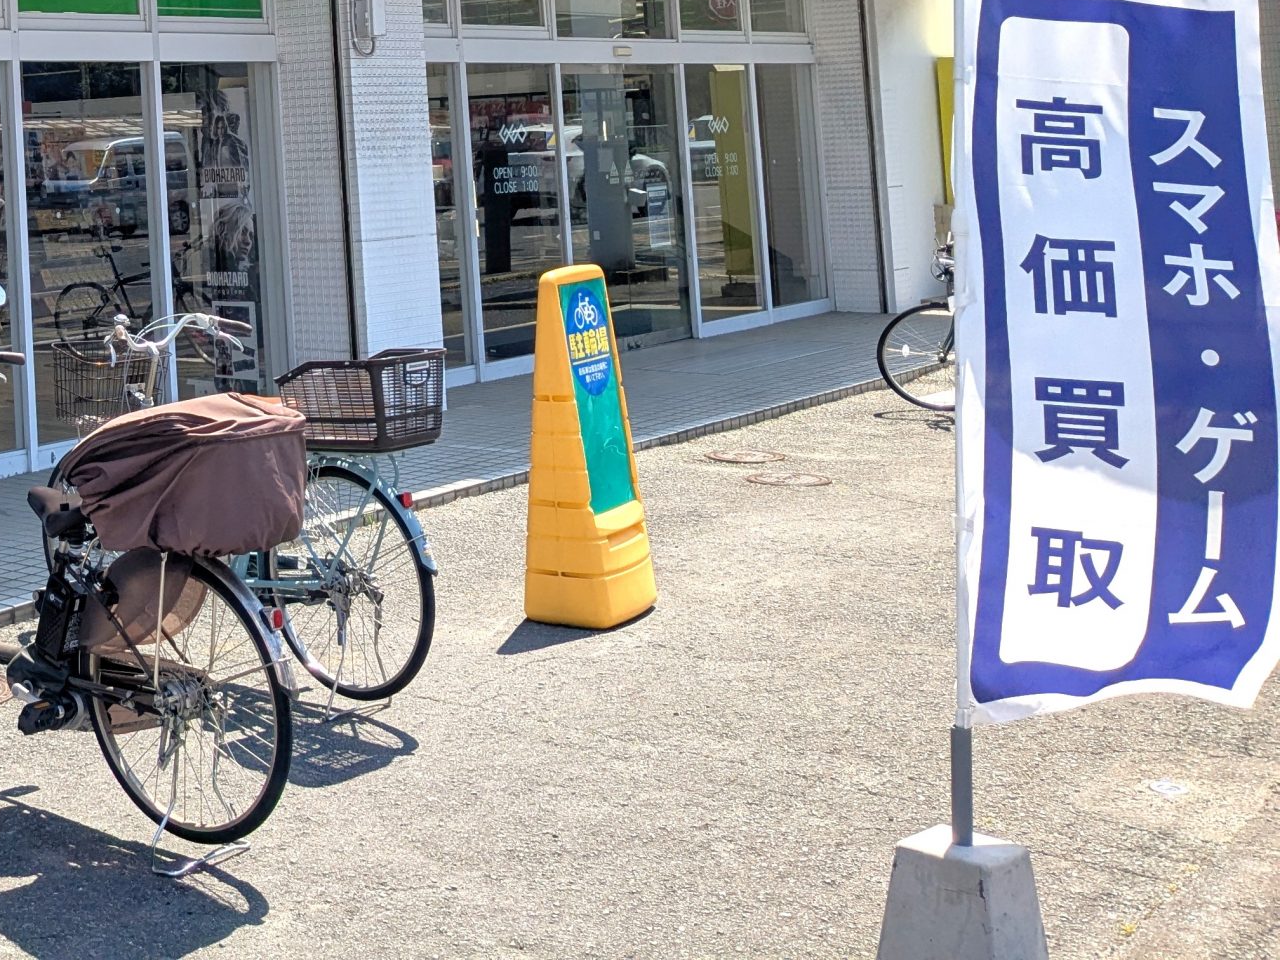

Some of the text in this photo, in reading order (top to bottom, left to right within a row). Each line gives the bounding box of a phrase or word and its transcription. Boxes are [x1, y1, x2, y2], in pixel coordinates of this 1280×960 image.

[704, 152, 738, 164] OPEN 9:00
[204, 167, 246, 183] BIOHAZARD
[493, 166, 538, 179] OPEN 9:00
[705, 165, 738, 177] CLOSE 1:00
[494, 180, 539, 194] CLOSE 1:00
[206, 271, 249, 287] BIOHAZARD
[568, 326, 609, 359] 駐輪場
[1016, 96, 1130, 611] 高価買取
[1149, 107, 1258, 629] スマホ・ゲーム
